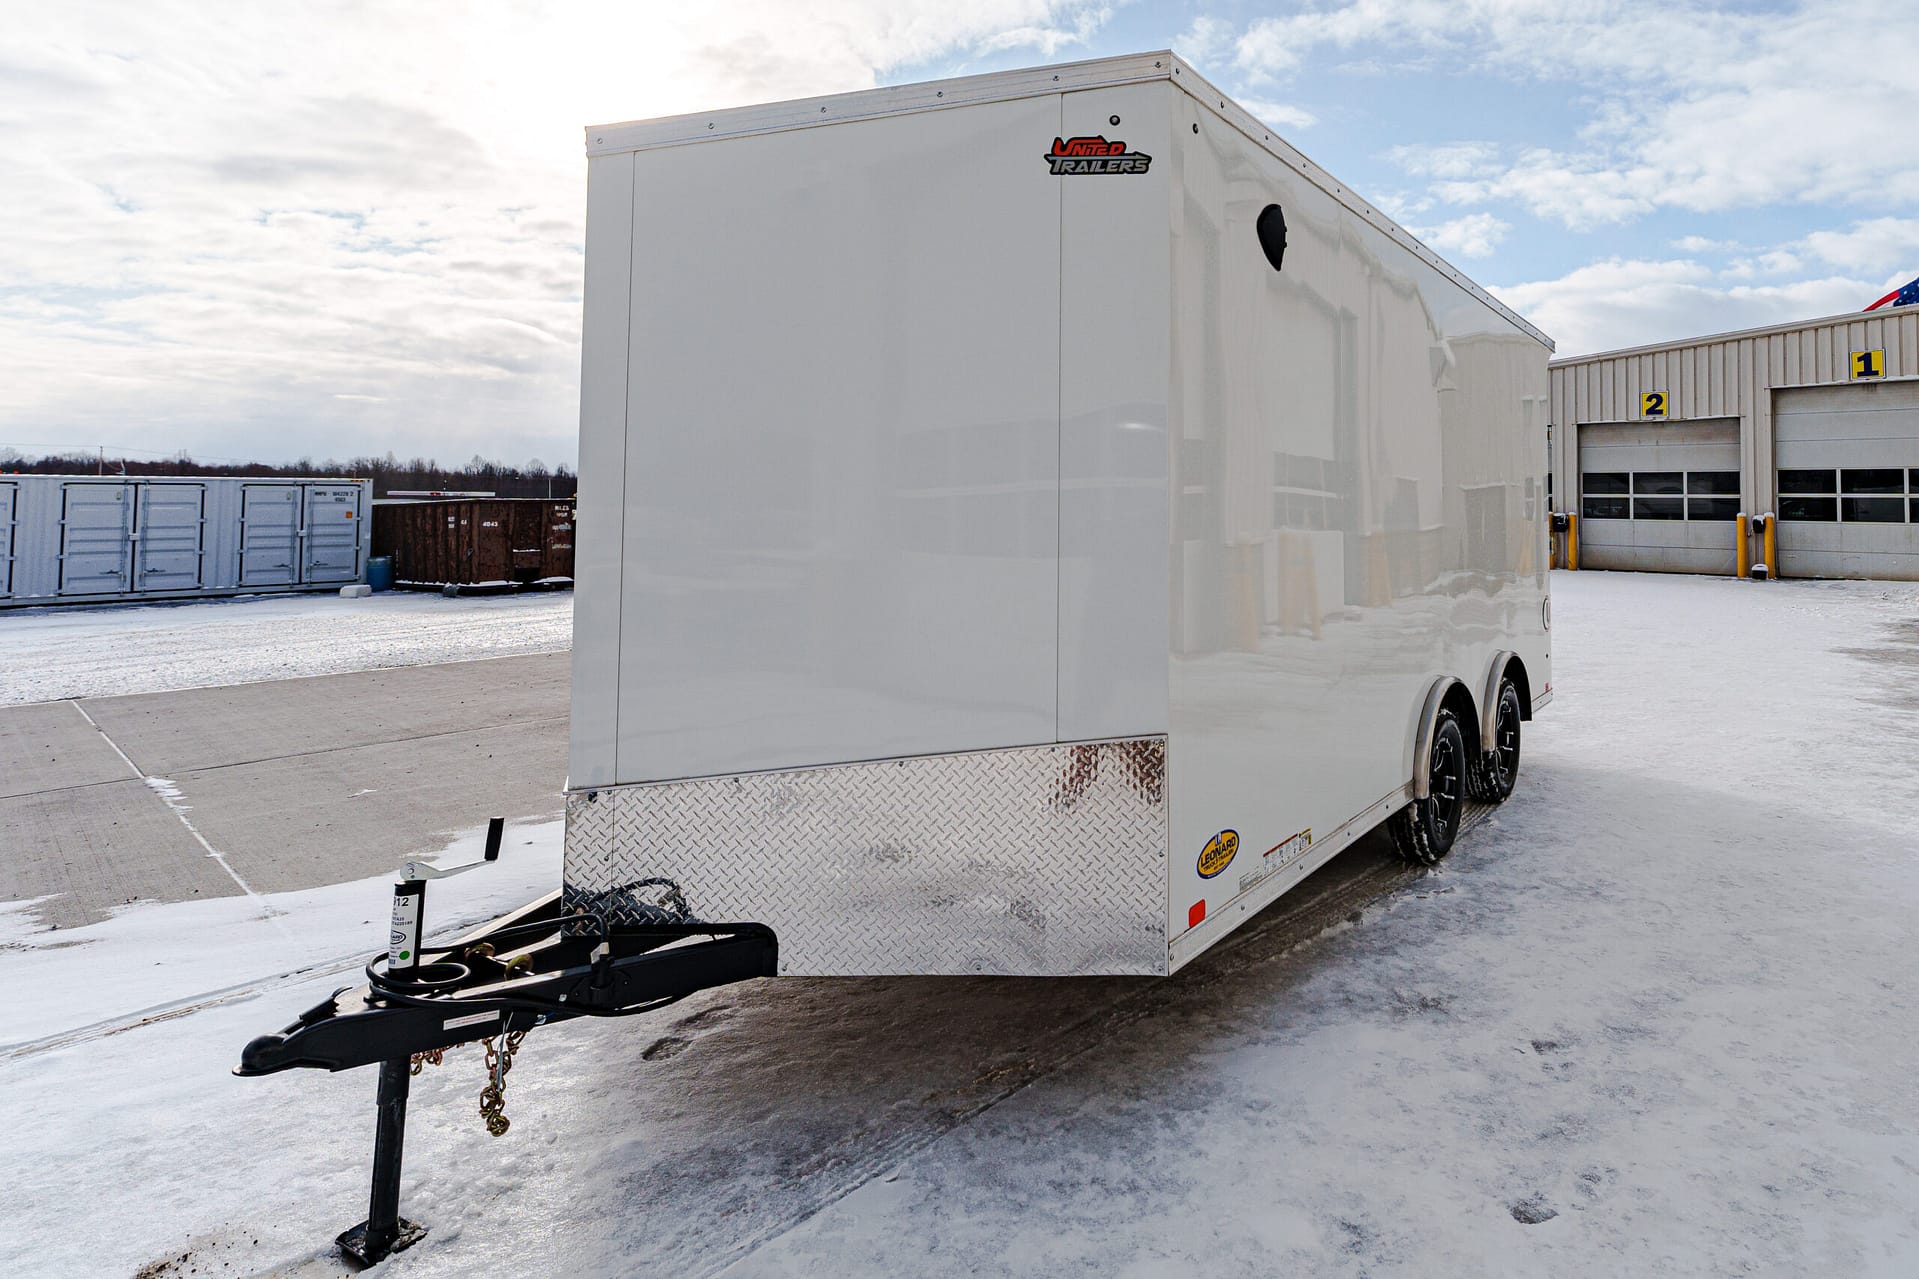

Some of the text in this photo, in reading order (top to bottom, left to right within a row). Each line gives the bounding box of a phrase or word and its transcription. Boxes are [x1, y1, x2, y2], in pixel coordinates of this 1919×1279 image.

[1053, 137, 1125, 156] UNITED
[1048, 154, 1150, 173] TRAILERS
[1857, 352, 1880, 377] 1
[1646, 393, 1664, 415] 2
[1200, 836, 1236, 868] LEONARD
